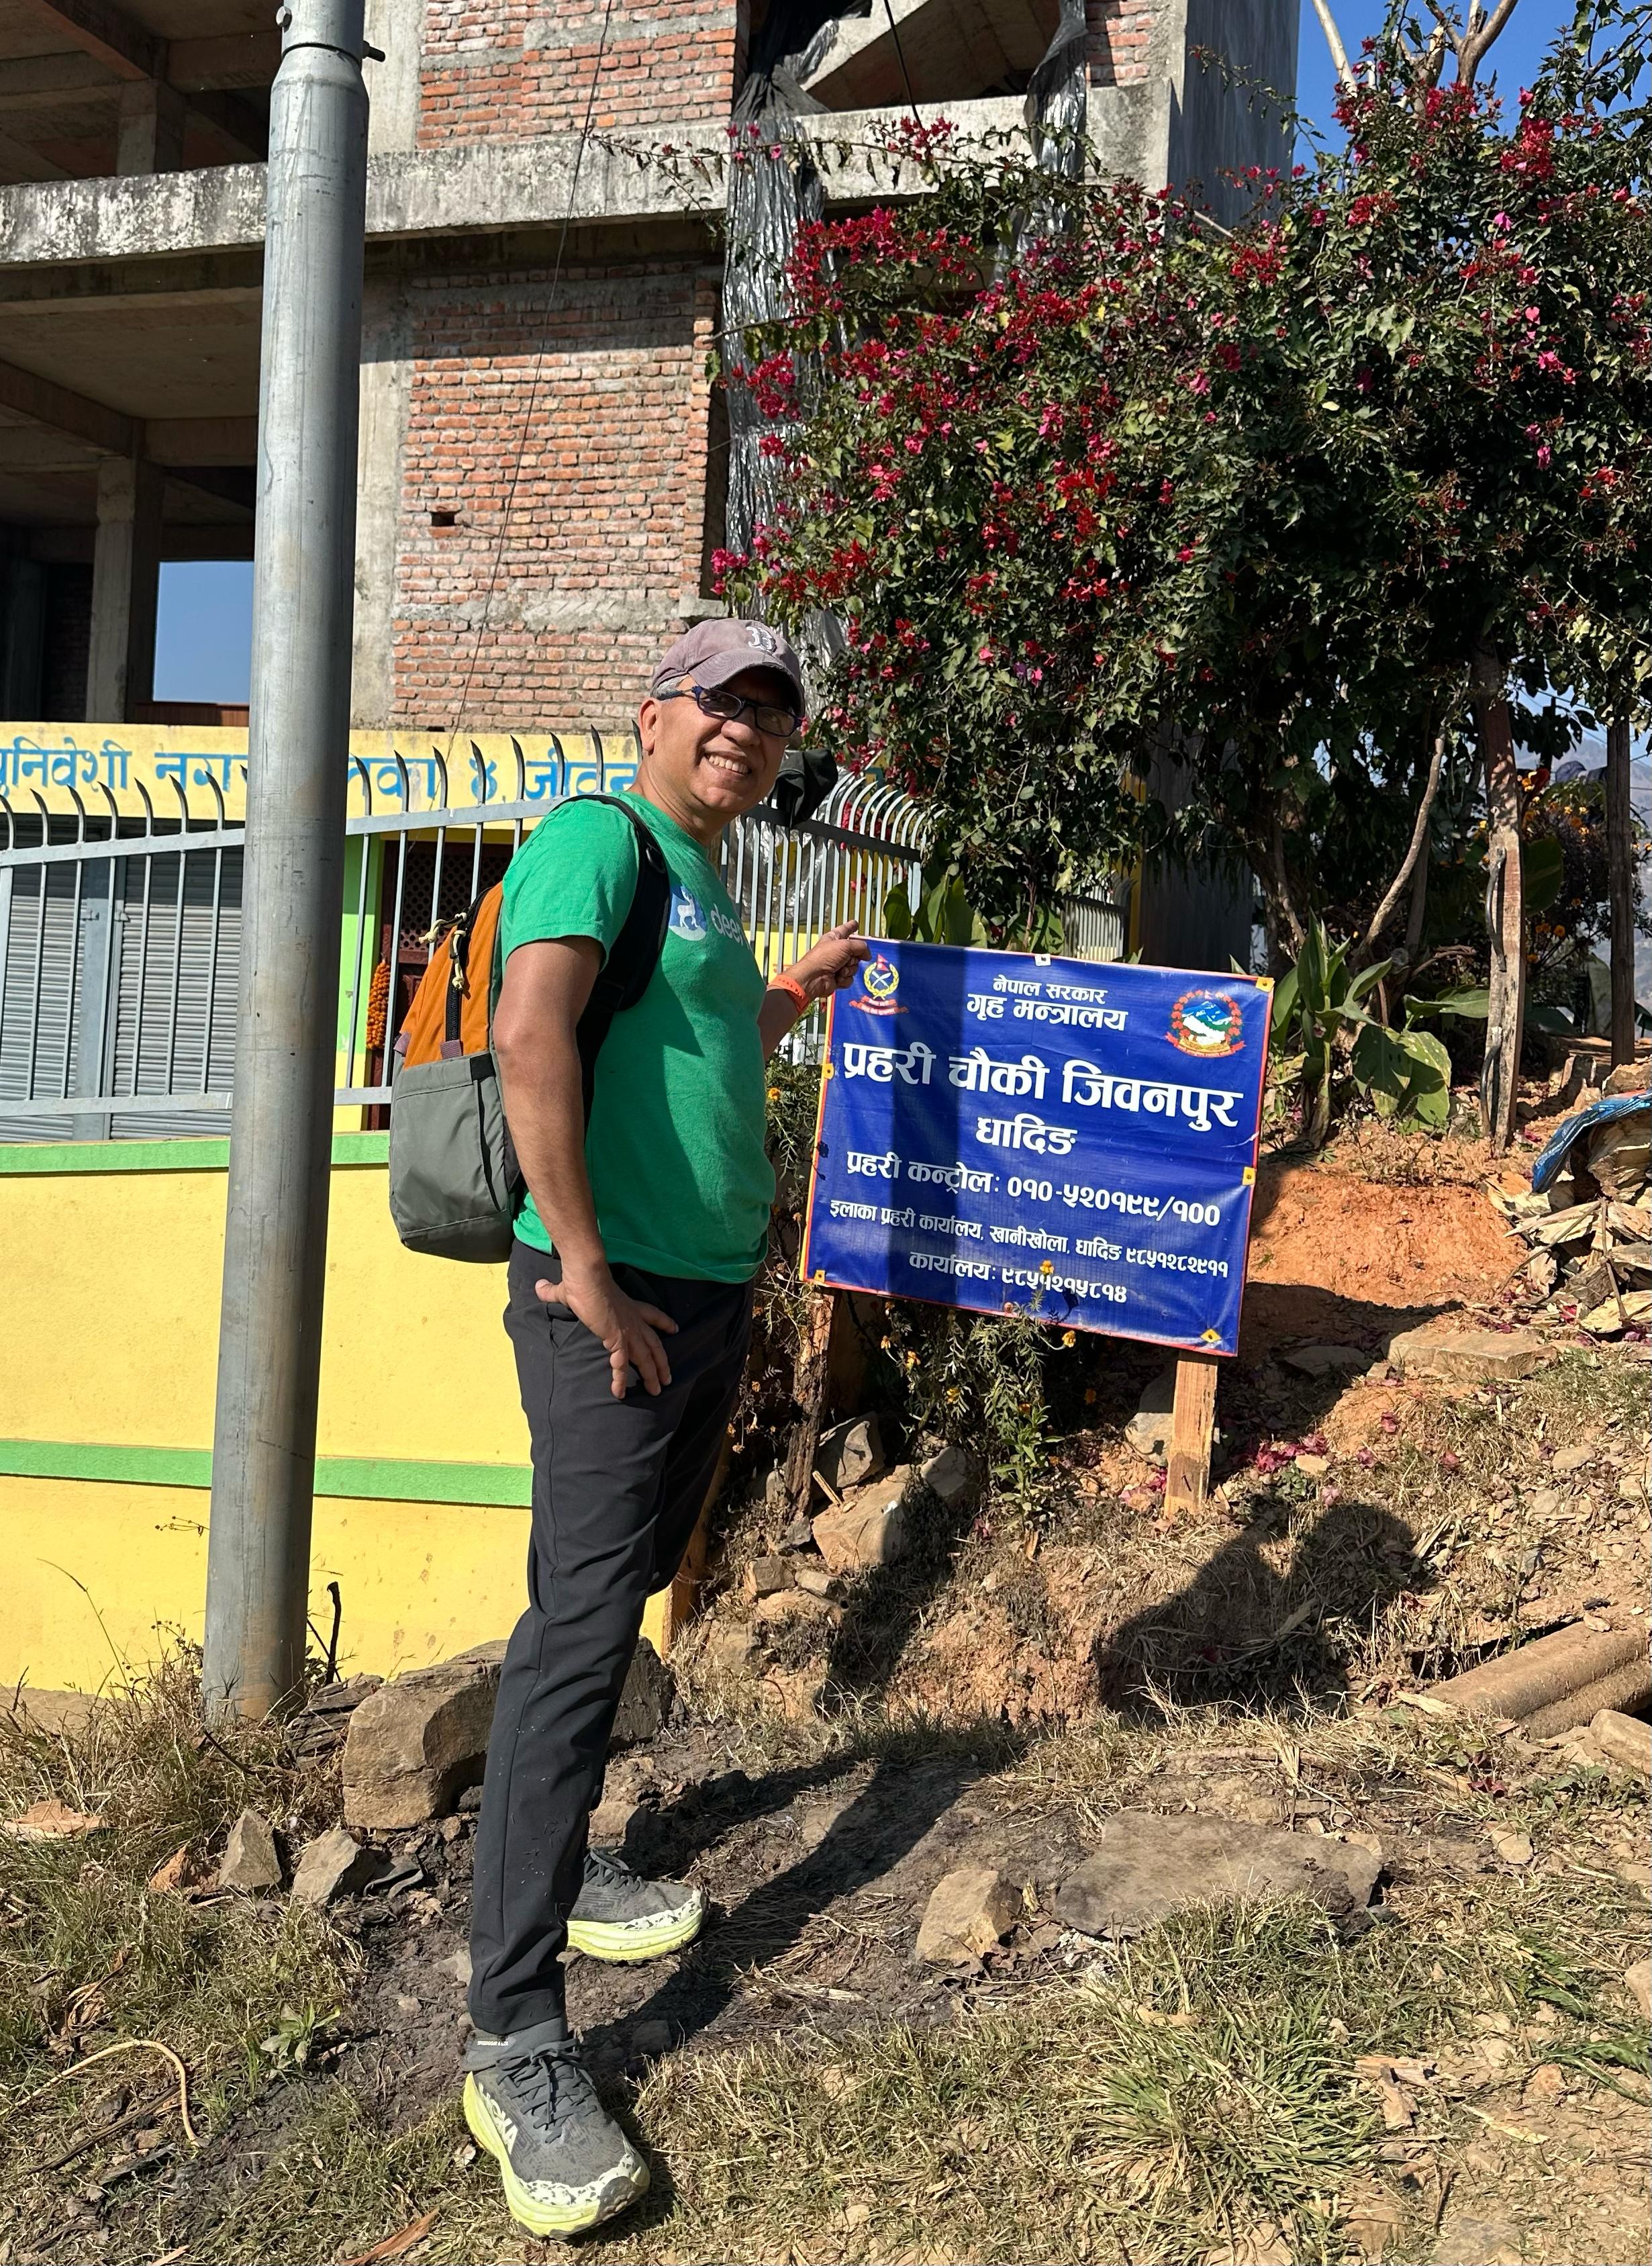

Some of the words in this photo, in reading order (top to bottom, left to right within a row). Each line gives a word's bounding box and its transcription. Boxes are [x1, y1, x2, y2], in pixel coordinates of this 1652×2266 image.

[710, 903, 749, 949] deer
[993, 974, 1042, 996] नेपाल
[1046, 983, 1108, 1004] सरकार
[967, 993, 1008, 1021] गृह
[1013, 998, 1128, 1031] मन्त्रालय
[843, 1041, 936, 1085] प्रहरी
[949, 1047, 1050, 1100] चौकी
[1062, 1059, 1244, 1132] जिवनपुर
[975, 1113, 1078, 1155] धादिङ
[846, 1151, 902, 1179] प्रहरी
[908, 1162, 1000, 1194] कन्ट्रोल:
[830, 1199, 878, 1221] इलाका
[880, 1207, 916, 1228] प्रहरी
[1075, 1236, 1122, 1262] धादिङ
[1126, 1247, 1229, 1278] ९८५१२८२९११
[908, 1251, 997, 1282] कार्यालय:
